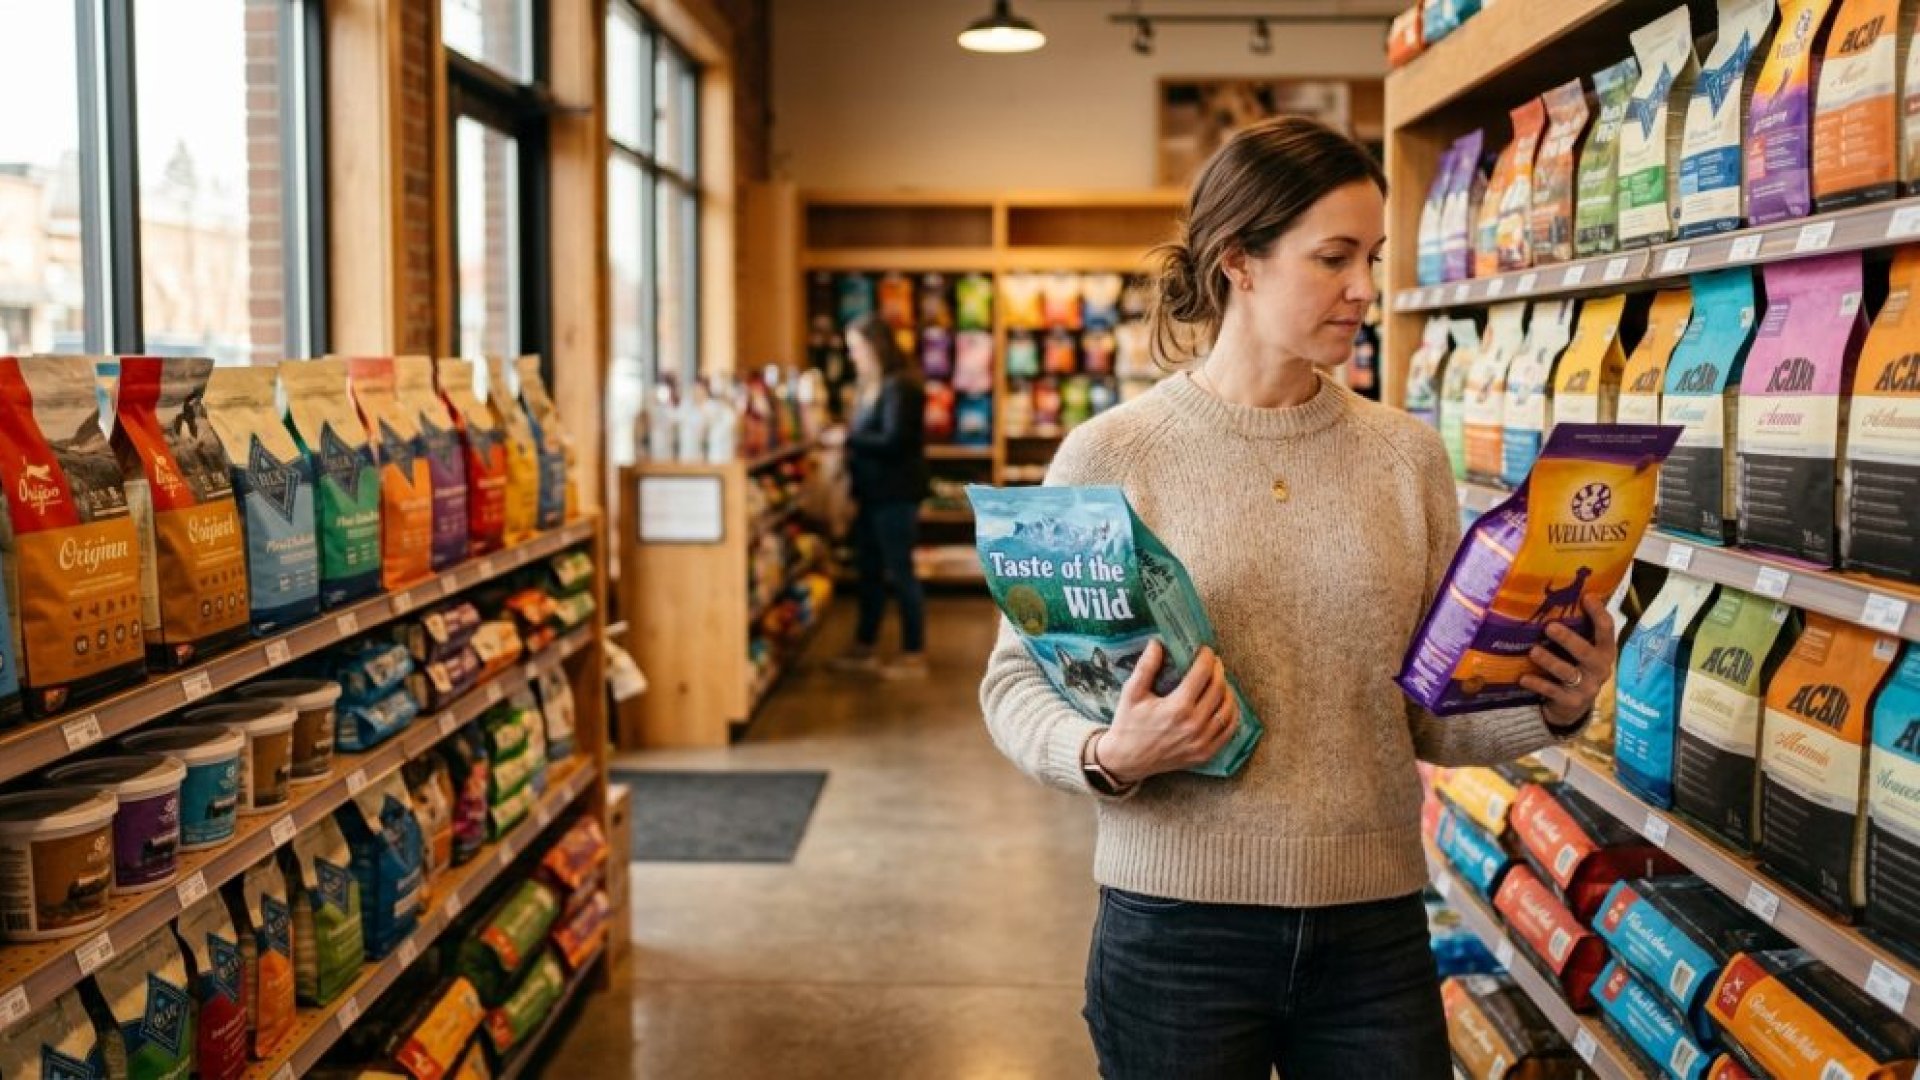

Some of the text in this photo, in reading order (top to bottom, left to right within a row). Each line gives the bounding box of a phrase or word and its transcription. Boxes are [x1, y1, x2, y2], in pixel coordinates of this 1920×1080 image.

[1548, 523, 1627, 543] WELLNESS
[990, 552, 1054, 577] Taste
[1061, 554, 1082, 580] of
[1089, 554, 1125, 582] the
[1063, 586, 1135, 621] Wild
